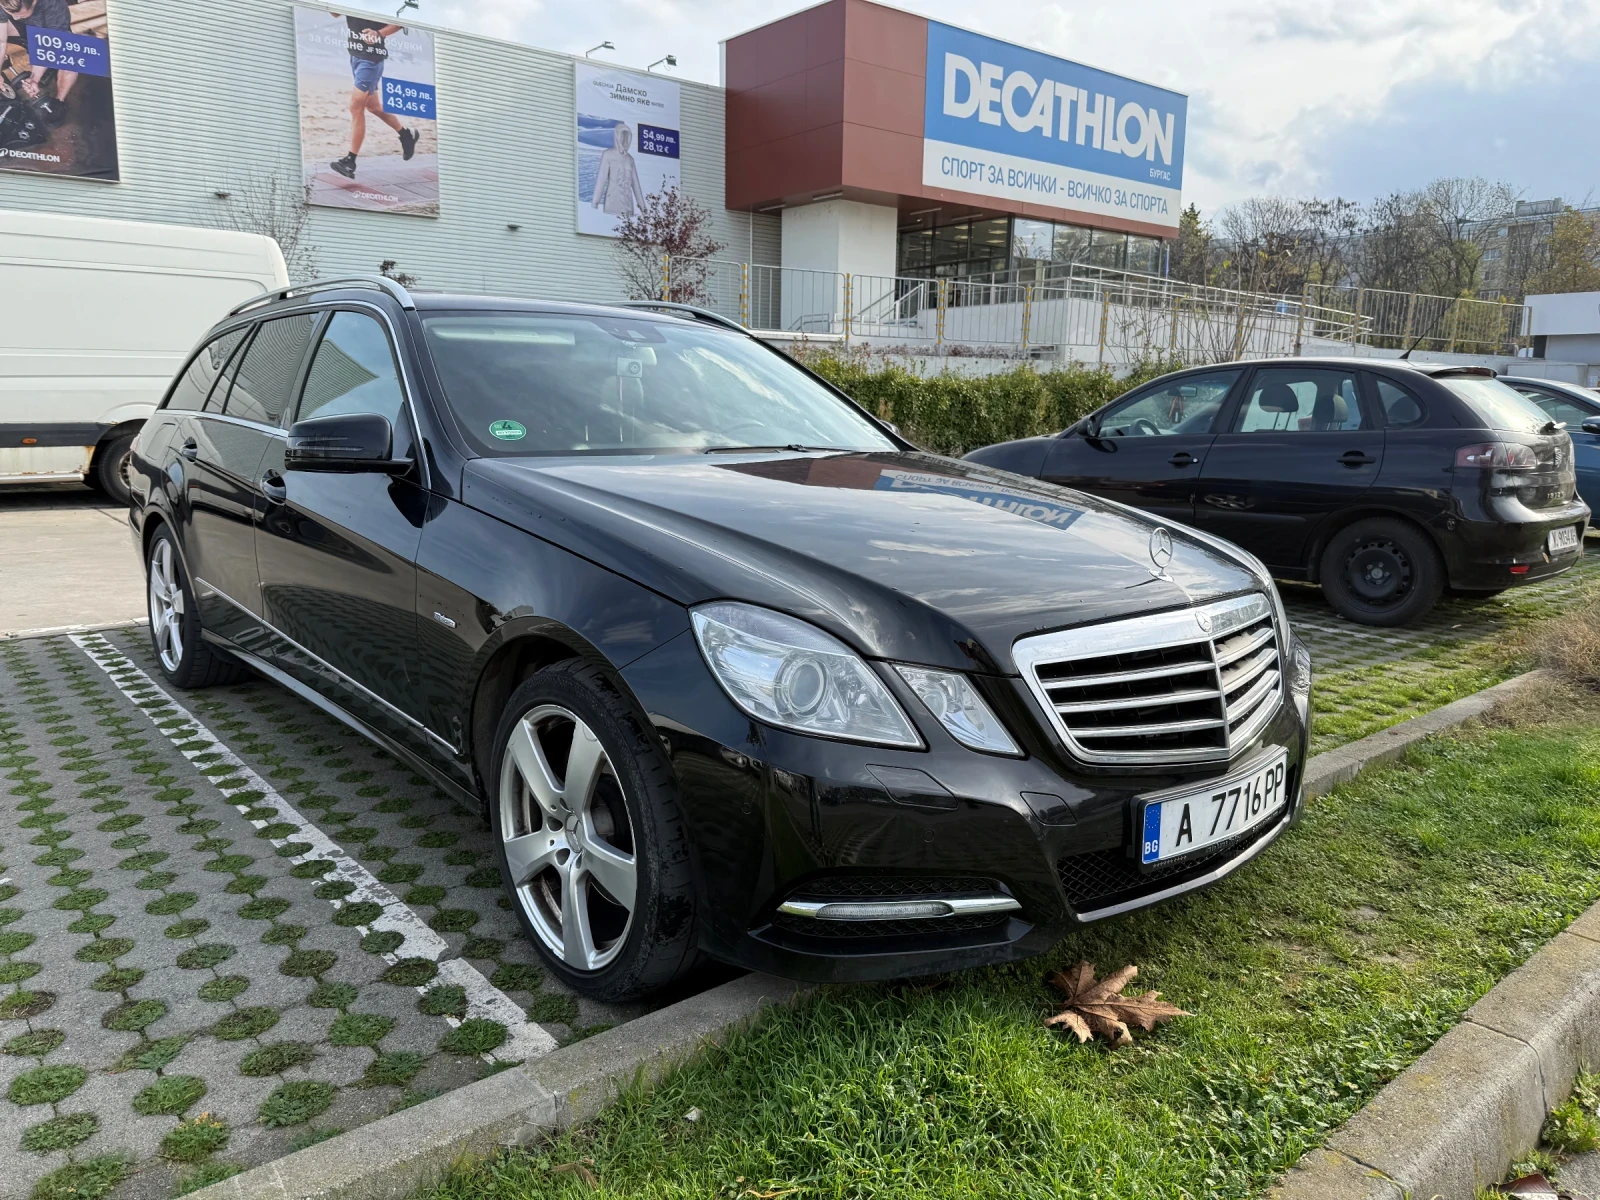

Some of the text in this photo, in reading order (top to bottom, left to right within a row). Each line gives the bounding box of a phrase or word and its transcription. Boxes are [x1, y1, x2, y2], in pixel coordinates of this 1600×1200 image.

[34, 34, 101, 56] 109,99 лв.
[308, 33, 322, 43] за
[324, 35, 363, 51] бягане
[340, 27, 382, 45] Мъжки
[384, 37, 423, 51] обувки
[36, 49, 86, 68] 56,24 €
[386, 82, 433, 101] 84,99 лв.
[615, 83, 647, 97] Дамско
[387, 96, 426, 113] 43,45 €
[609, 92, 635, 103] зимно
[636, 97, 651, 106] яке
[943, 52, 1175, 166] DECATHLON
[642, 129, 676, 144] 54,99 лв.
[643, 140, 670, 154] 28,12 €
[9, 149, 61, 163] DECATHLON
[1149, 168, 1171, 181] БУРГАС
[941, 156, 985, 182] СПОРТ
[988, 164, 1005, 186] ЗА
[1007, 168, 1057, 195] ВСИЧКИ
[1067, 180, 1112, 204] ВСИЧКО
[1113, 189, 1128, 207] ЗА
[1129, 192, 1169, 215] СПОРТА
[1175, 803, 1193, 847] A
[1144, 840, 1158, 855] BG
